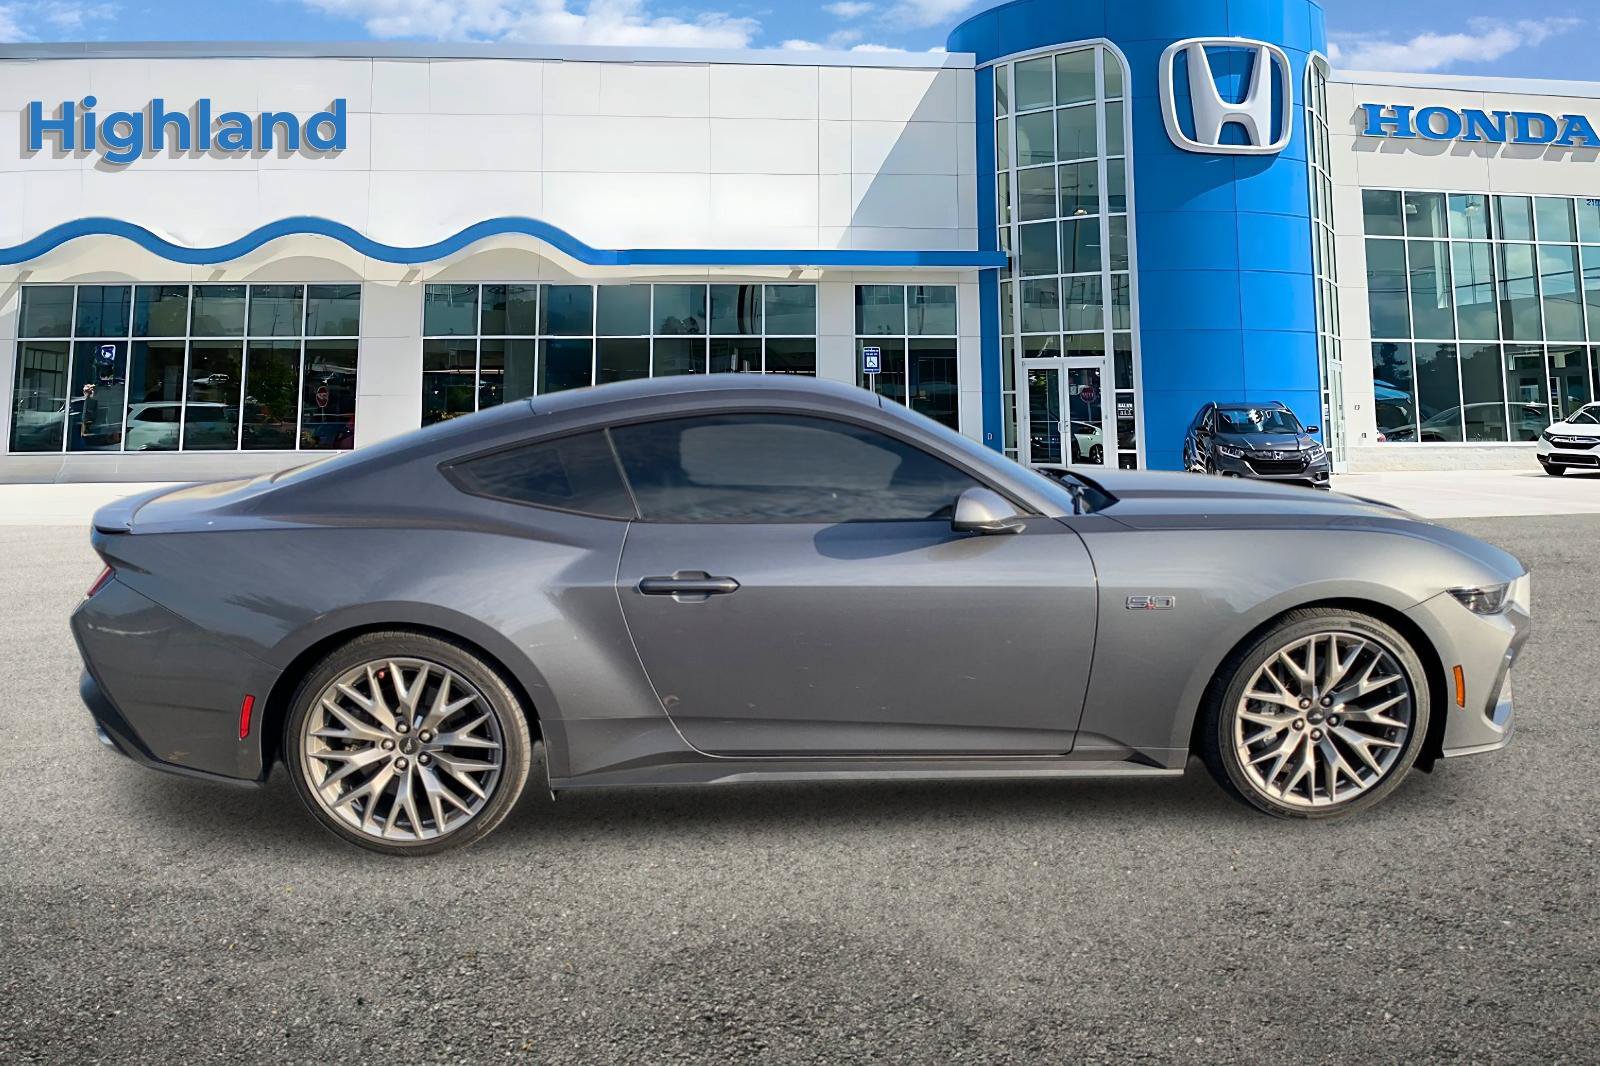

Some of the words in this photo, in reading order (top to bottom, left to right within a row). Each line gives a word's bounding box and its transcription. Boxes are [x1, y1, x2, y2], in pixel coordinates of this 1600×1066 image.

[28, 96, 348, 164] Highland
[1361, 103, 1600, 147] HONDA
[1126, 595, 1176, 610] 5.0
